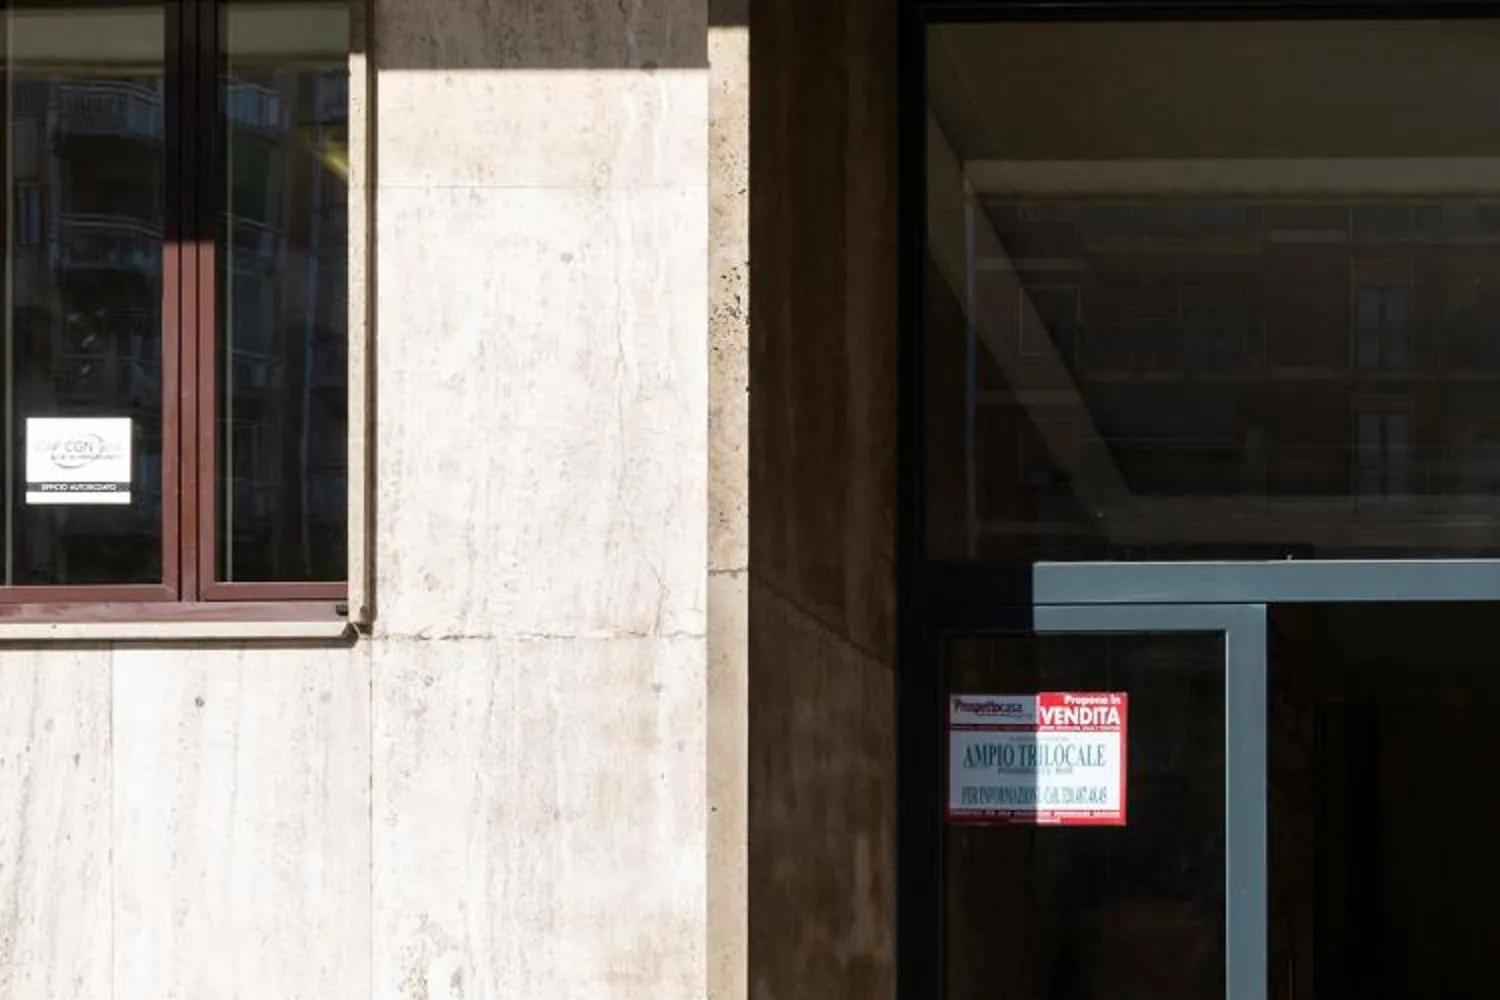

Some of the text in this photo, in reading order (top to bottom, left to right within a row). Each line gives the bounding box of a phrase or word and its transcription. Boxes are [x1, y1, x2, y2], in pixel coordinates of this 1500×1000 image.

[1040, 706, 1121, 725] VENDITA
[963, 743, 1106, 769] AMPIO TRILOCALE
